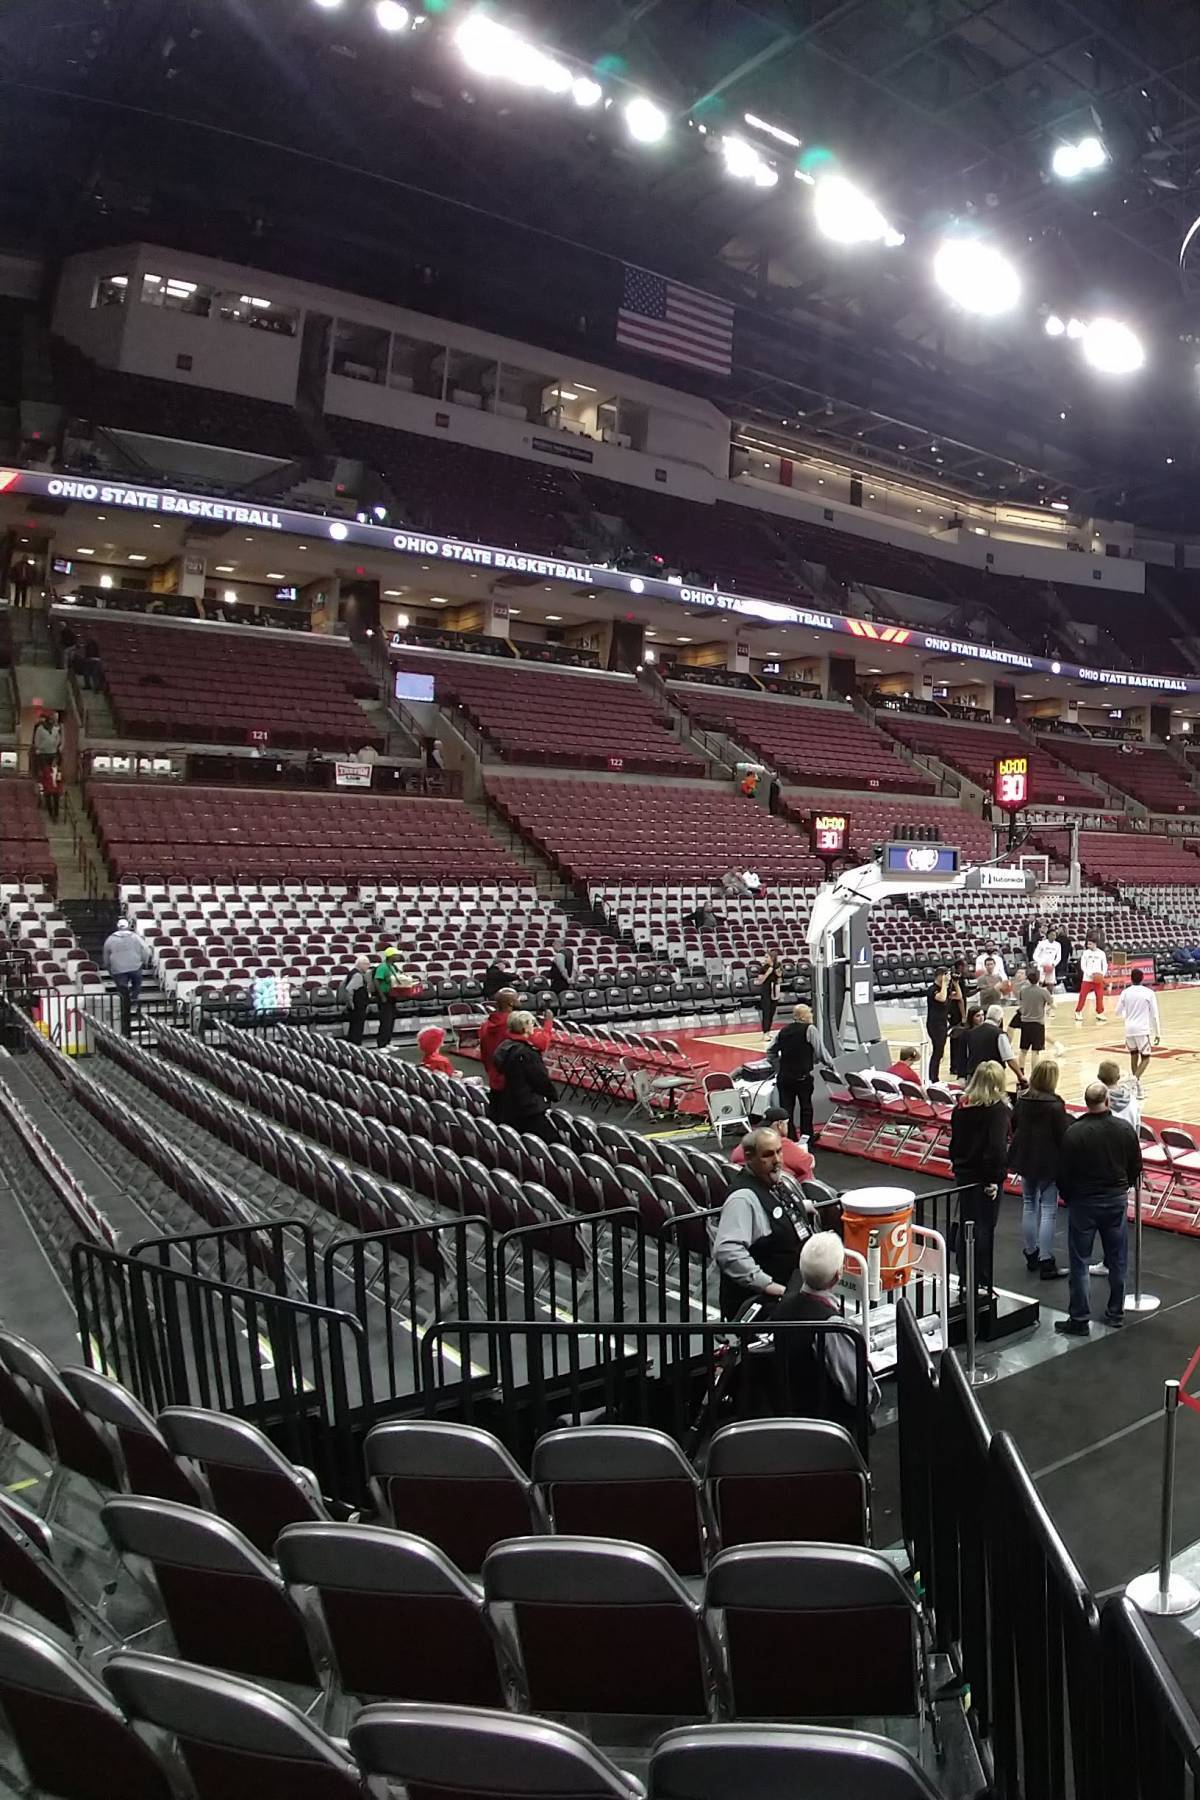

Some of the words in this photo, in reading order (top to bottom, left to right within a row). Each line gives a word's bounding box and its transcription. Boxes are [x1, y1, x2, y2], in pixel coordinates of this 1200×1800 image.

[48, 479, 97, 500] OHIO
[100, 486, 158, 509] STATE
[162, 496, 281, 529] BASKETBALL
[394, 535, 438, 555] OHIO
[442, 543, 491, 565] STATE
[495, 553, 593, 583] BASKETBALL
[680, 588, 715, 606] OHIO
[925, 637, 949, 651] OHIO
[951, 640, 978, 656] STATE
[979, 644, 1033, 668] BASKETBALL
[1079, 668, 1098, 681] OHIO
[1099, 671, 1127, 685] STATE
[1128, 676, 1187, 691] BASKETBALL
[252, 729, 268, 741] 121
[611, 758, 623, 767] 122
[999, 758, 1027, 774] 60:00
[1002, 774, 1025, 801] 30
[815, 816, 845, 831] 60:00
[820, 831, 838, 848] 30
[891, 1222, 908, 1248] G
